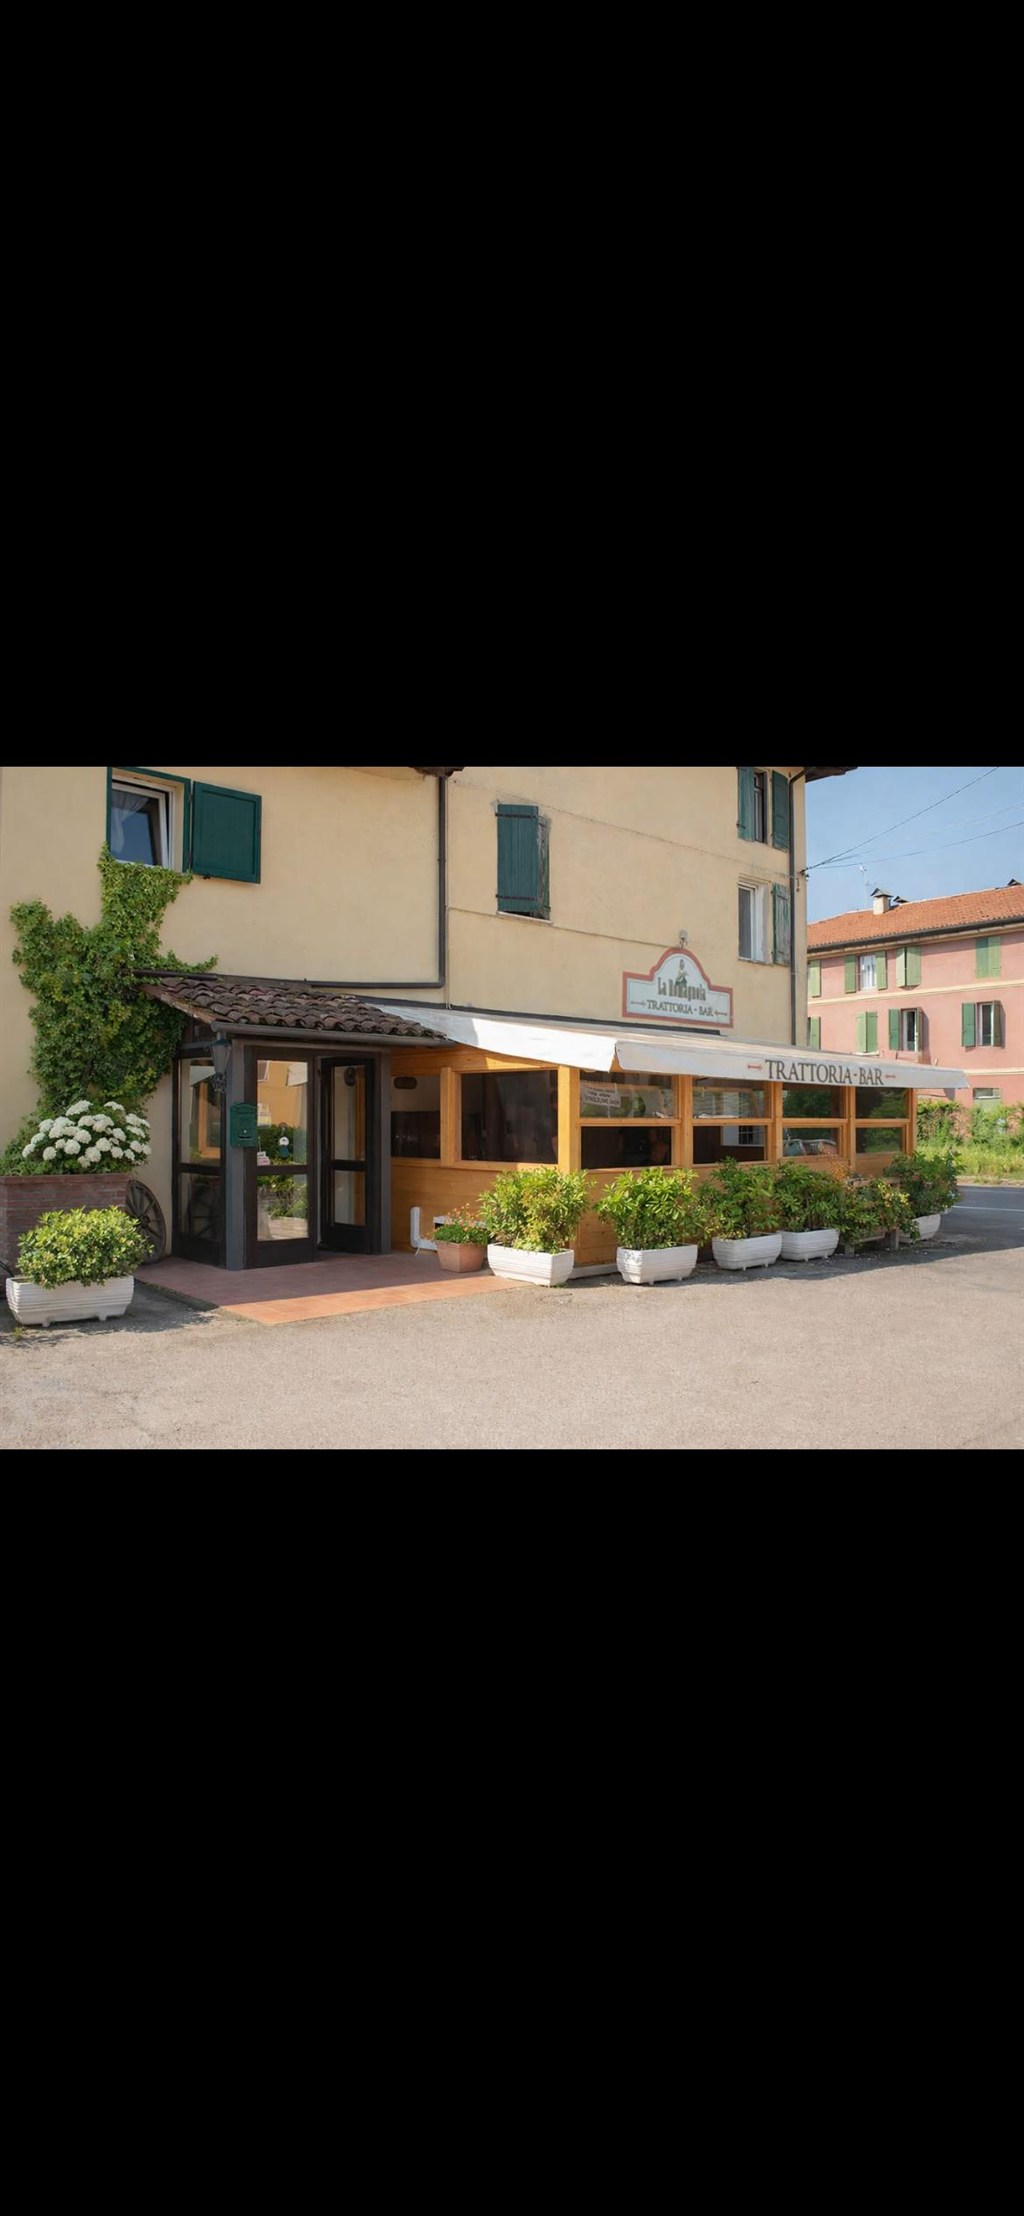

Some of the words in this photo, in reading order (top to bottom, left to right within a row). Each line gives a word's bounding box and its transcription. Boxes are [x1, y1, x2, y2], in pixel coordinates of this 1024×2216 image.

[657, 977, 667, 996] La
[646, 1000, 693, 1014] TRATTORIA
[699, 1006, 714, 1017] BAR
